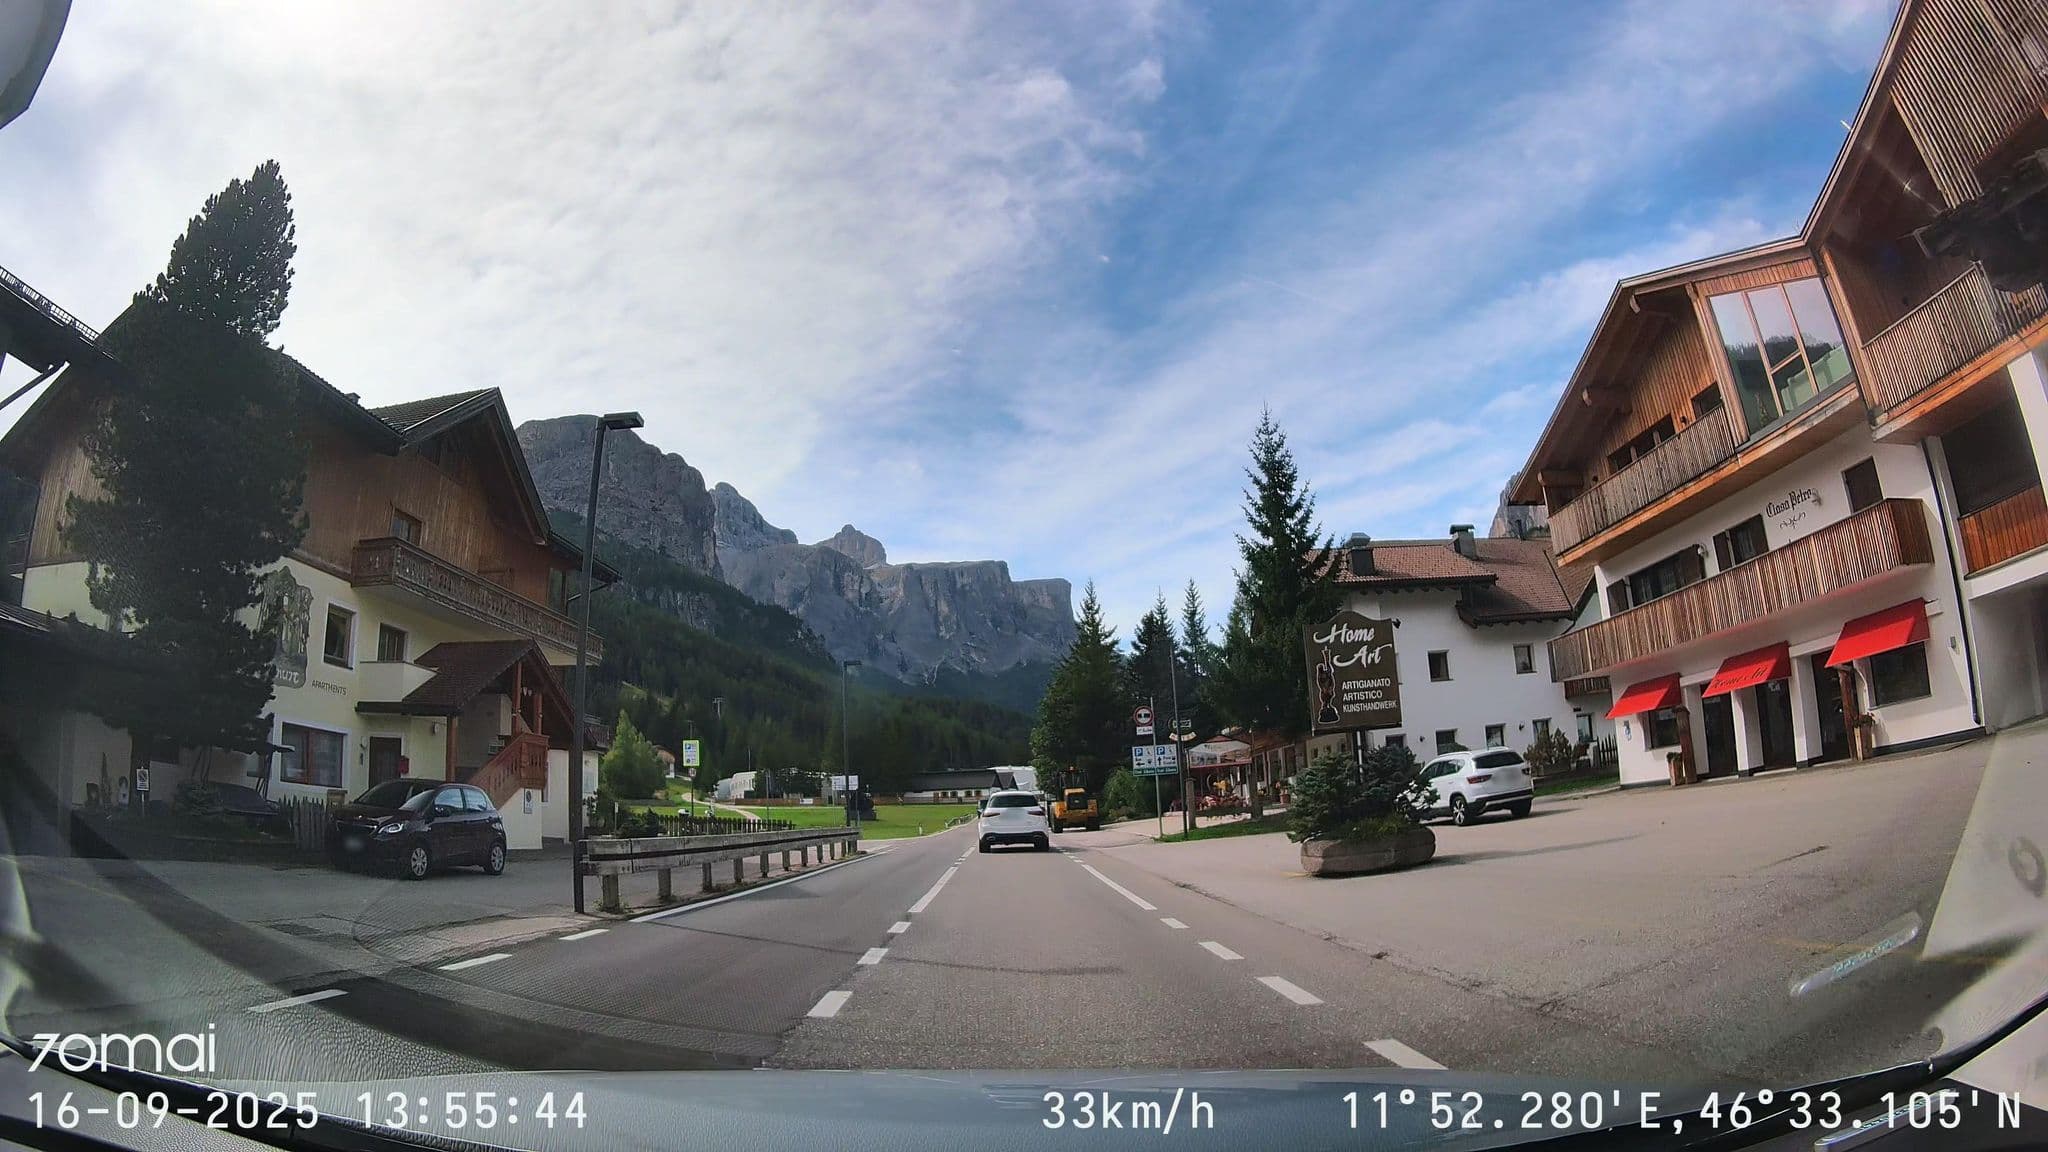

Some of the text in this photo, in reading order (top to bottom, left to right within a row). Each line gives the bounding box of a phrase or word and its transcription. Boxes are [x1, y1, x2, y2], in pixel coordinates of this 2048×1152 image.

[1313, 623, 1375, 644] Home
[1333, 643, 1393, 668] Art
[312, 680, 347, 696] APARTMENTS
[1342, 677, 1391, 691] ARTIGIANATO
[1342, 689, 1383, 702] ARTISTICO
[1342, 700, 1397, 713] KUNSTHANDWERK
